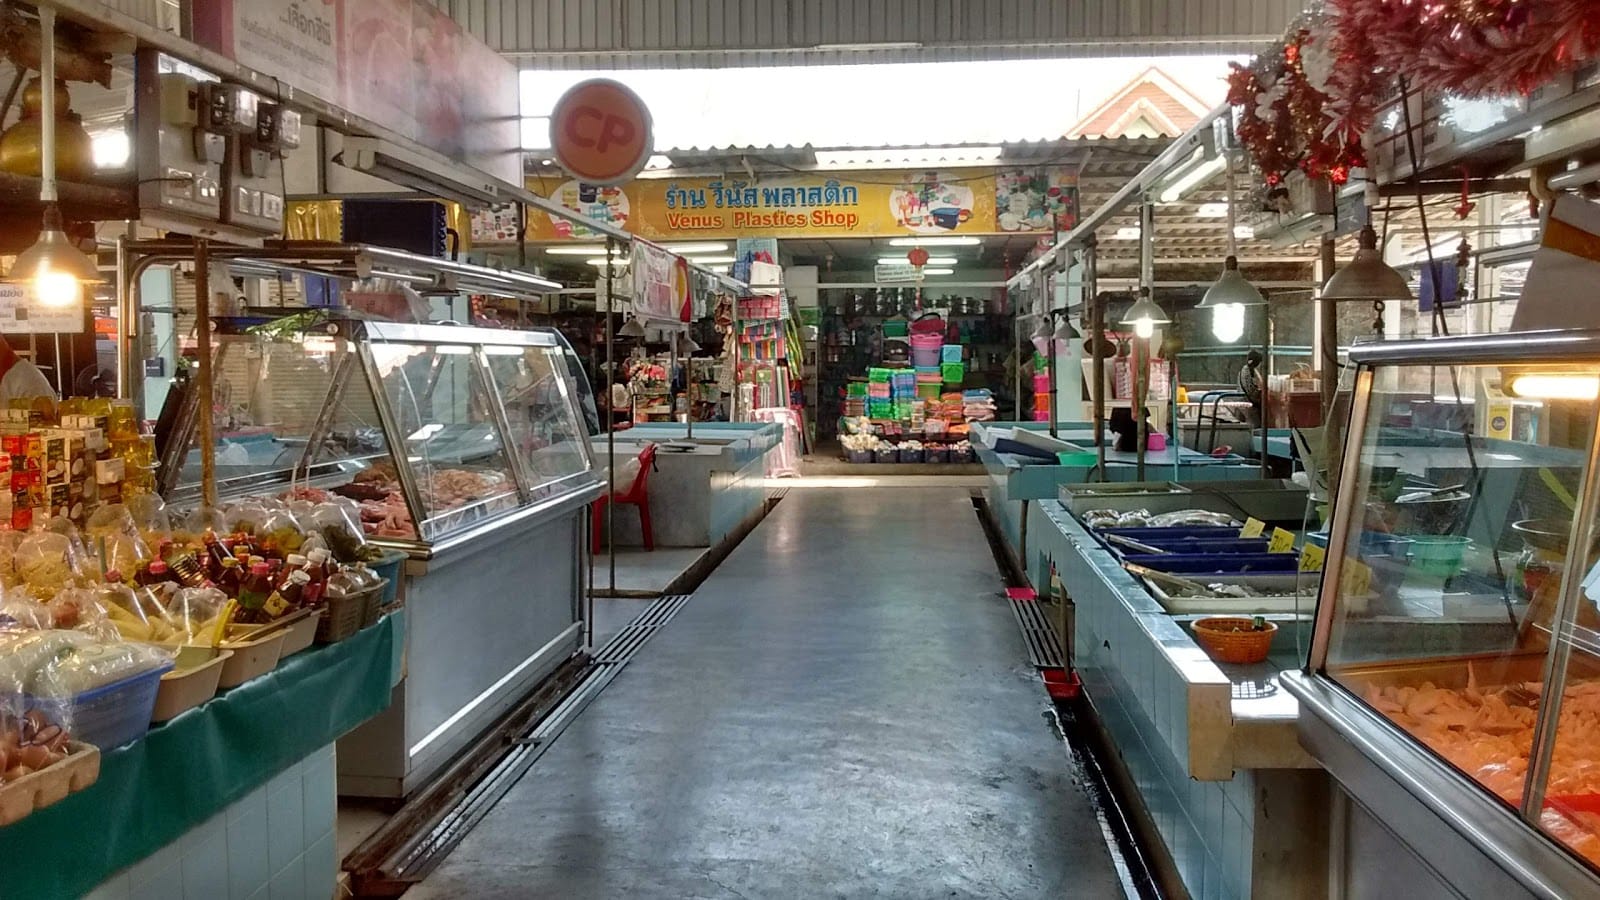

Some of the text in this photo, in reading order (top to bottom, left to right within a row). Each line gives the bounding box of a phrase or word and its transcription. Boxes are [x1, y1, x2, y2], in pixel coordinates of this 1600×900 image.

[565, 105, 635, 153] CP
[666, 180, 858, 208] ร้าน วีนัส พลาสติก
[667, 209, 858, 229] Venus Plastics Shop
